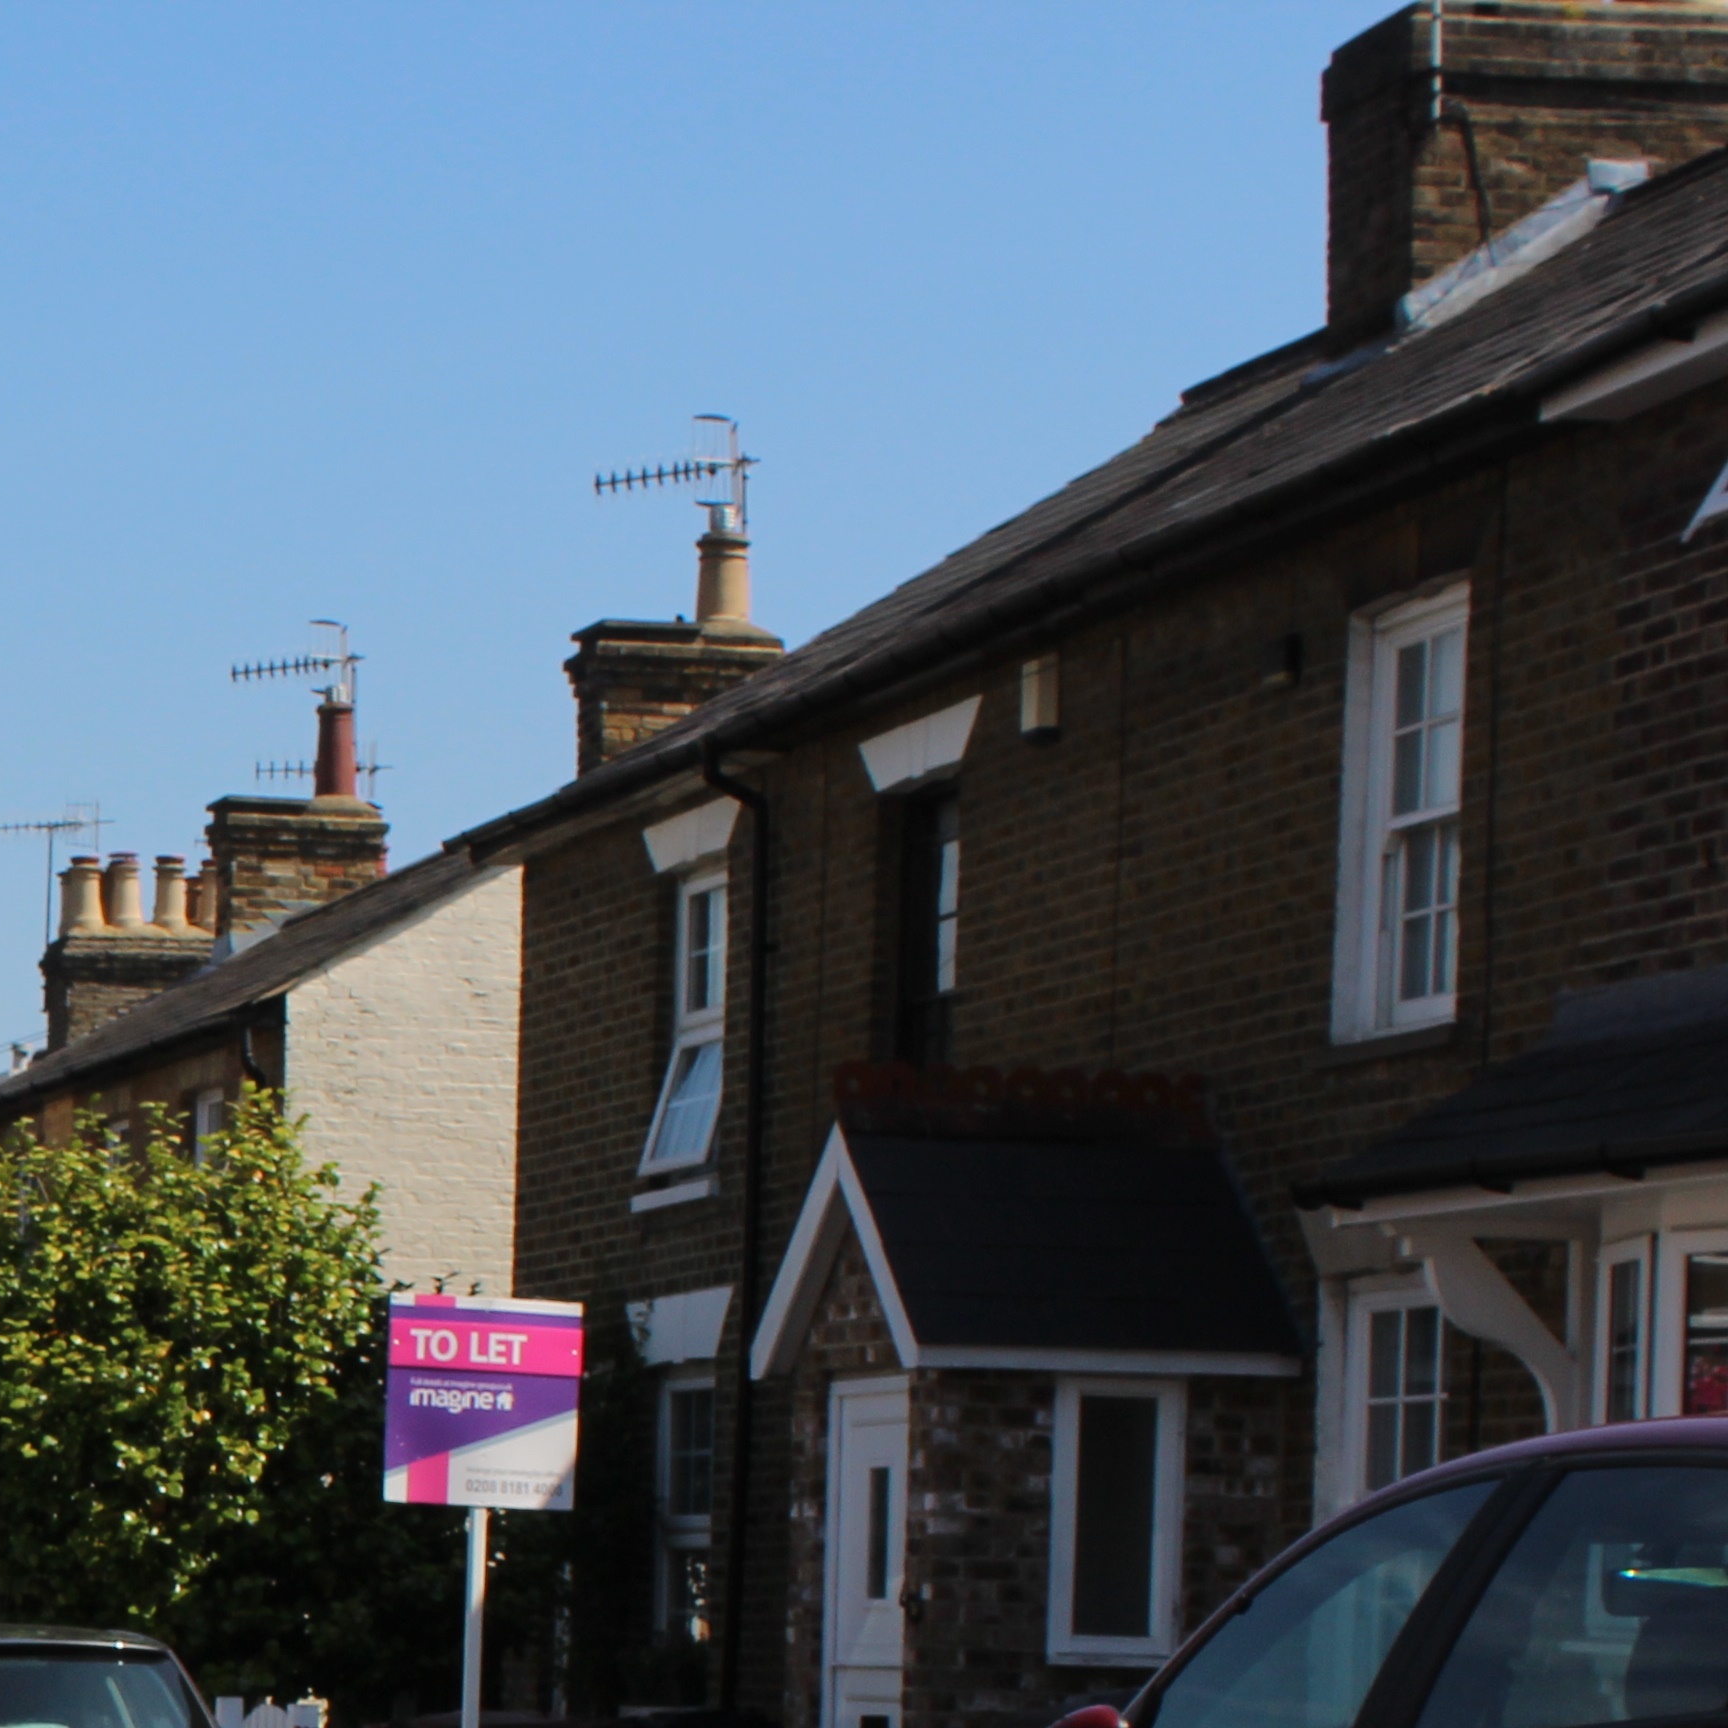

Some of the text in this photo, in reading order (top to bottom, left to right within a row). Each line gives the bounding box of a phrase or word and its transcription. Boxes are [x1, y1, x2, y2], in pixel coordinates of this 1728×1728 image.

[410, 1328, 528, 1366] TO LET
[409, 1388, 494, 1414] imagine
